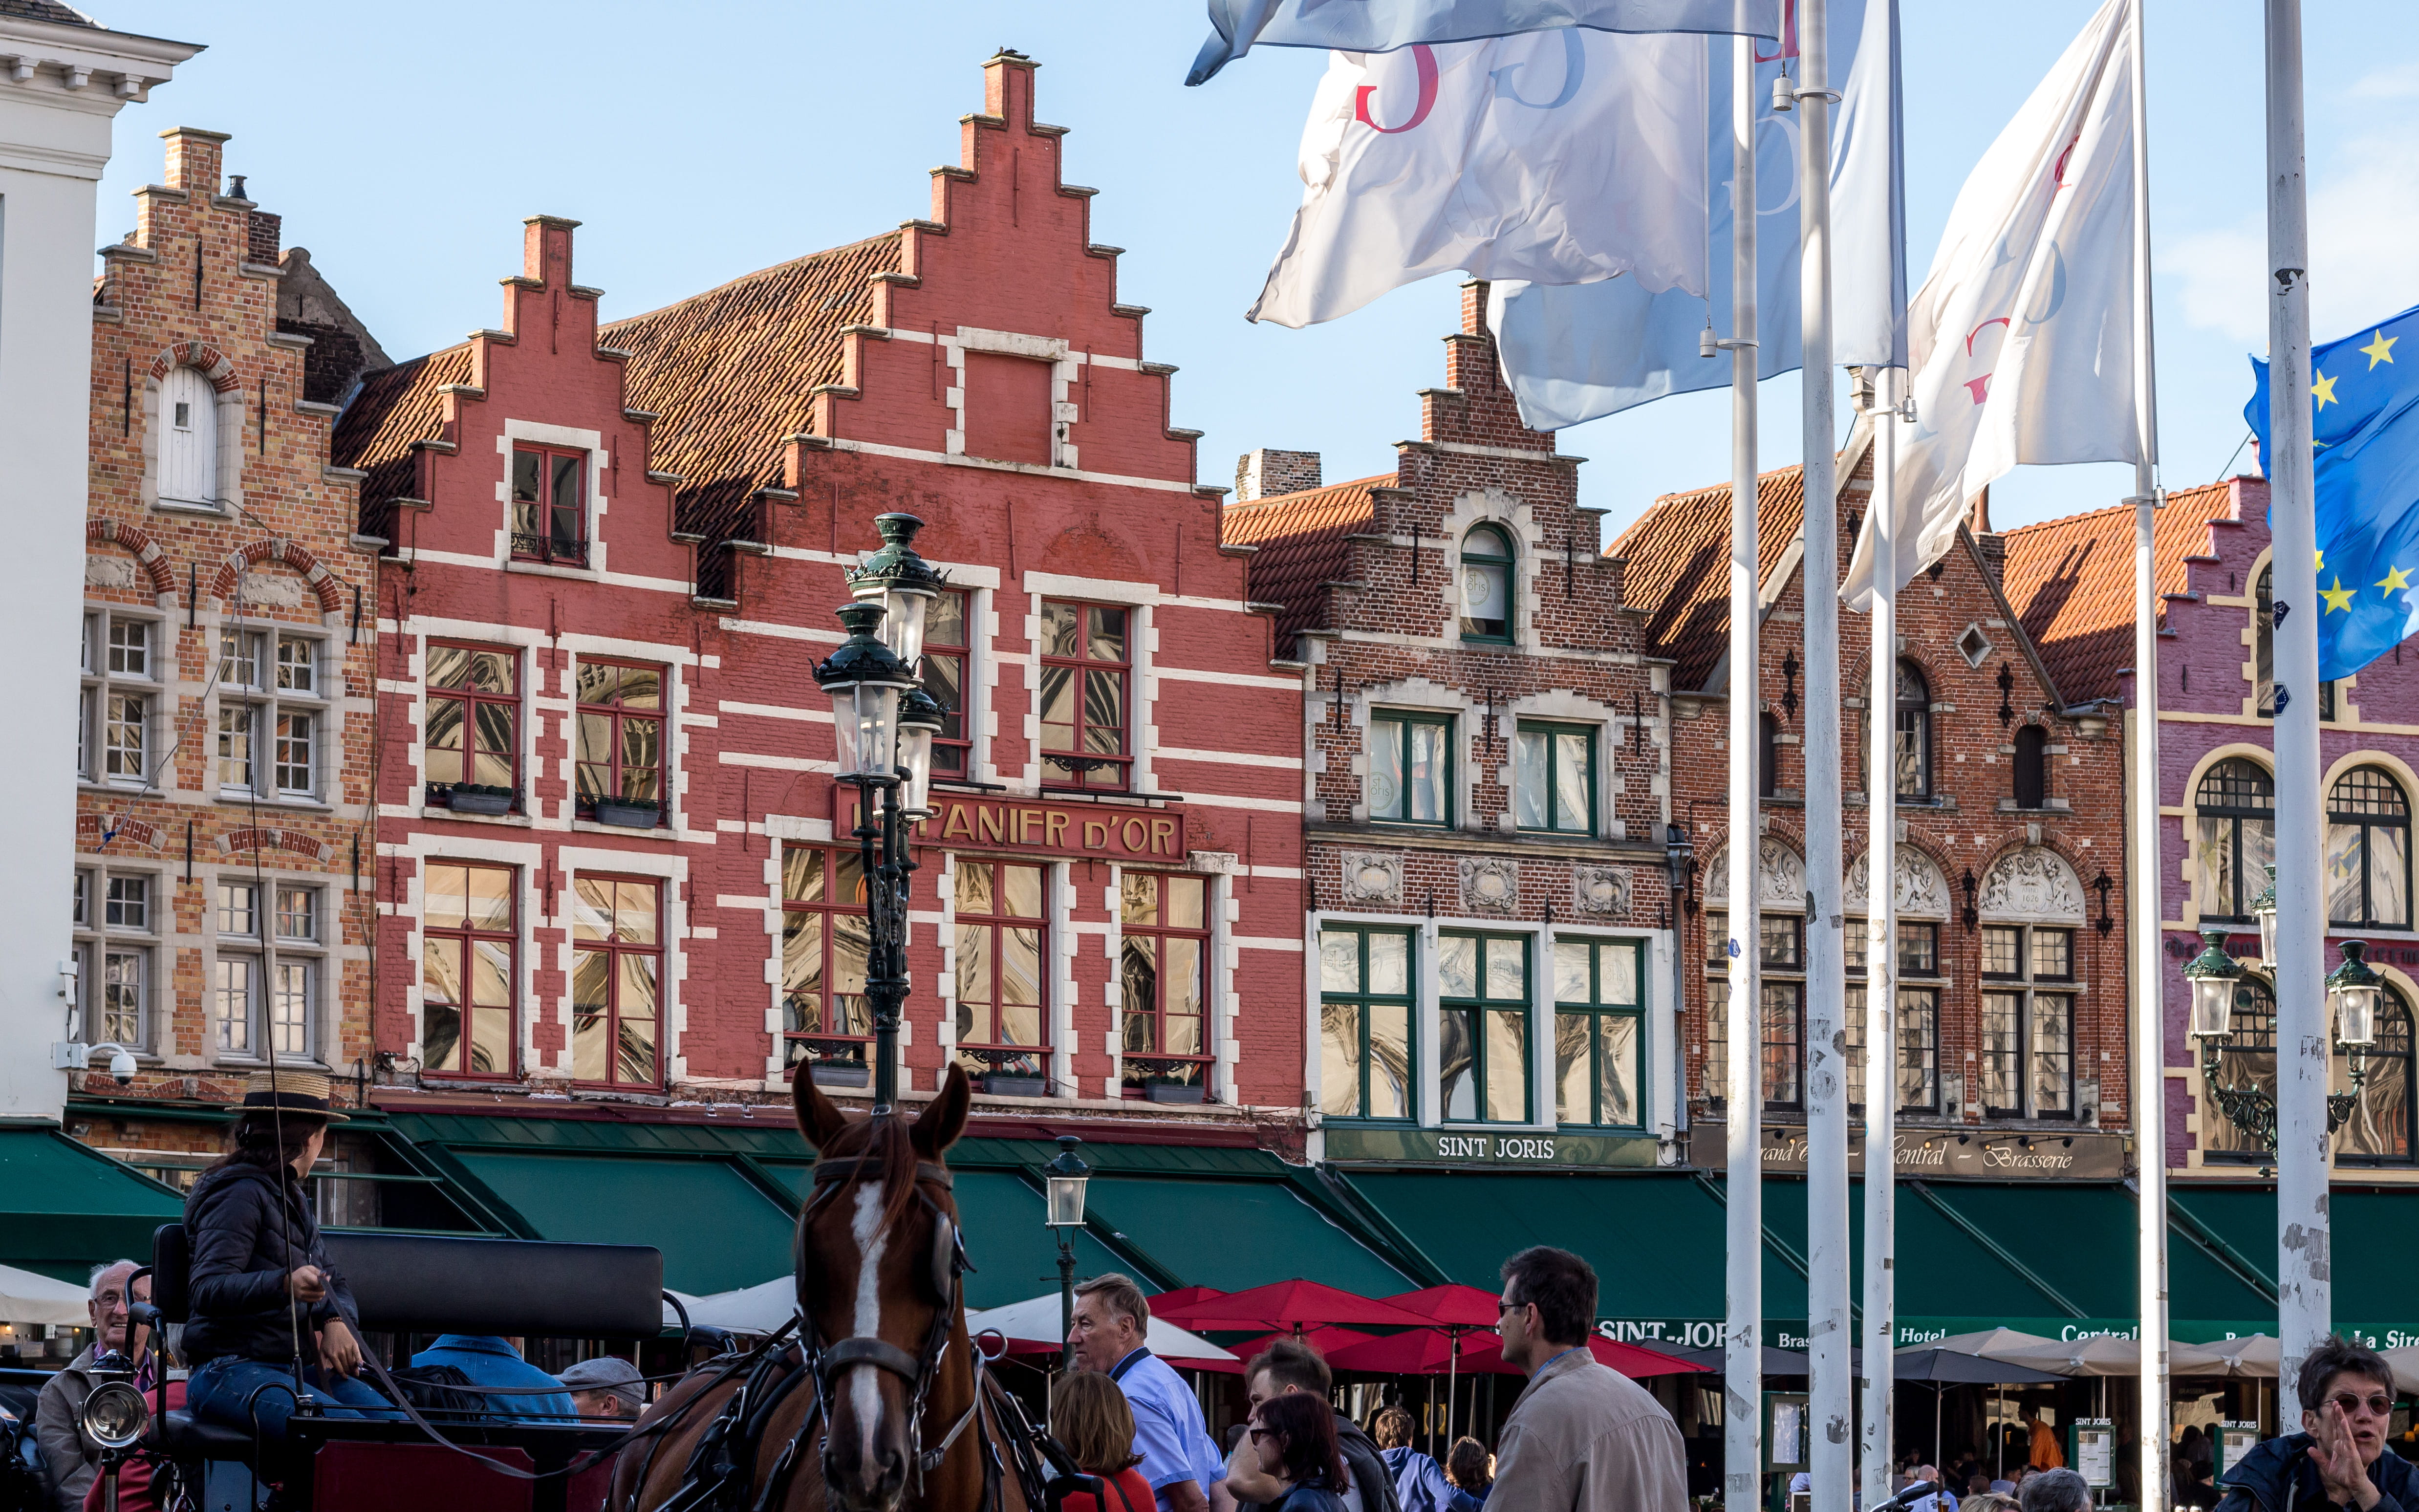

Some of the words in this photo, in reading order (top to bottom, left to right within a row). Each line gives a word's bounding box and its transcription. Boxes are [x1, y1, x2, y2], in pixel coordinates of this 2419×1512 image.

[918, 801, 1070, 847] PANIER
[1083, 816, 1175, 855] D'OR
[2023, 894, 2039, 903] 1626
[1438, 1137, 1487, 1157] SINT
[1495, 1139, 1555, 1159] JORIS
[1759, 1143, 1794, 1162] rand
[1983, 1146, 2073, 1169] Brasserie
[1900, 1328, 1945, 1342] Hotel
